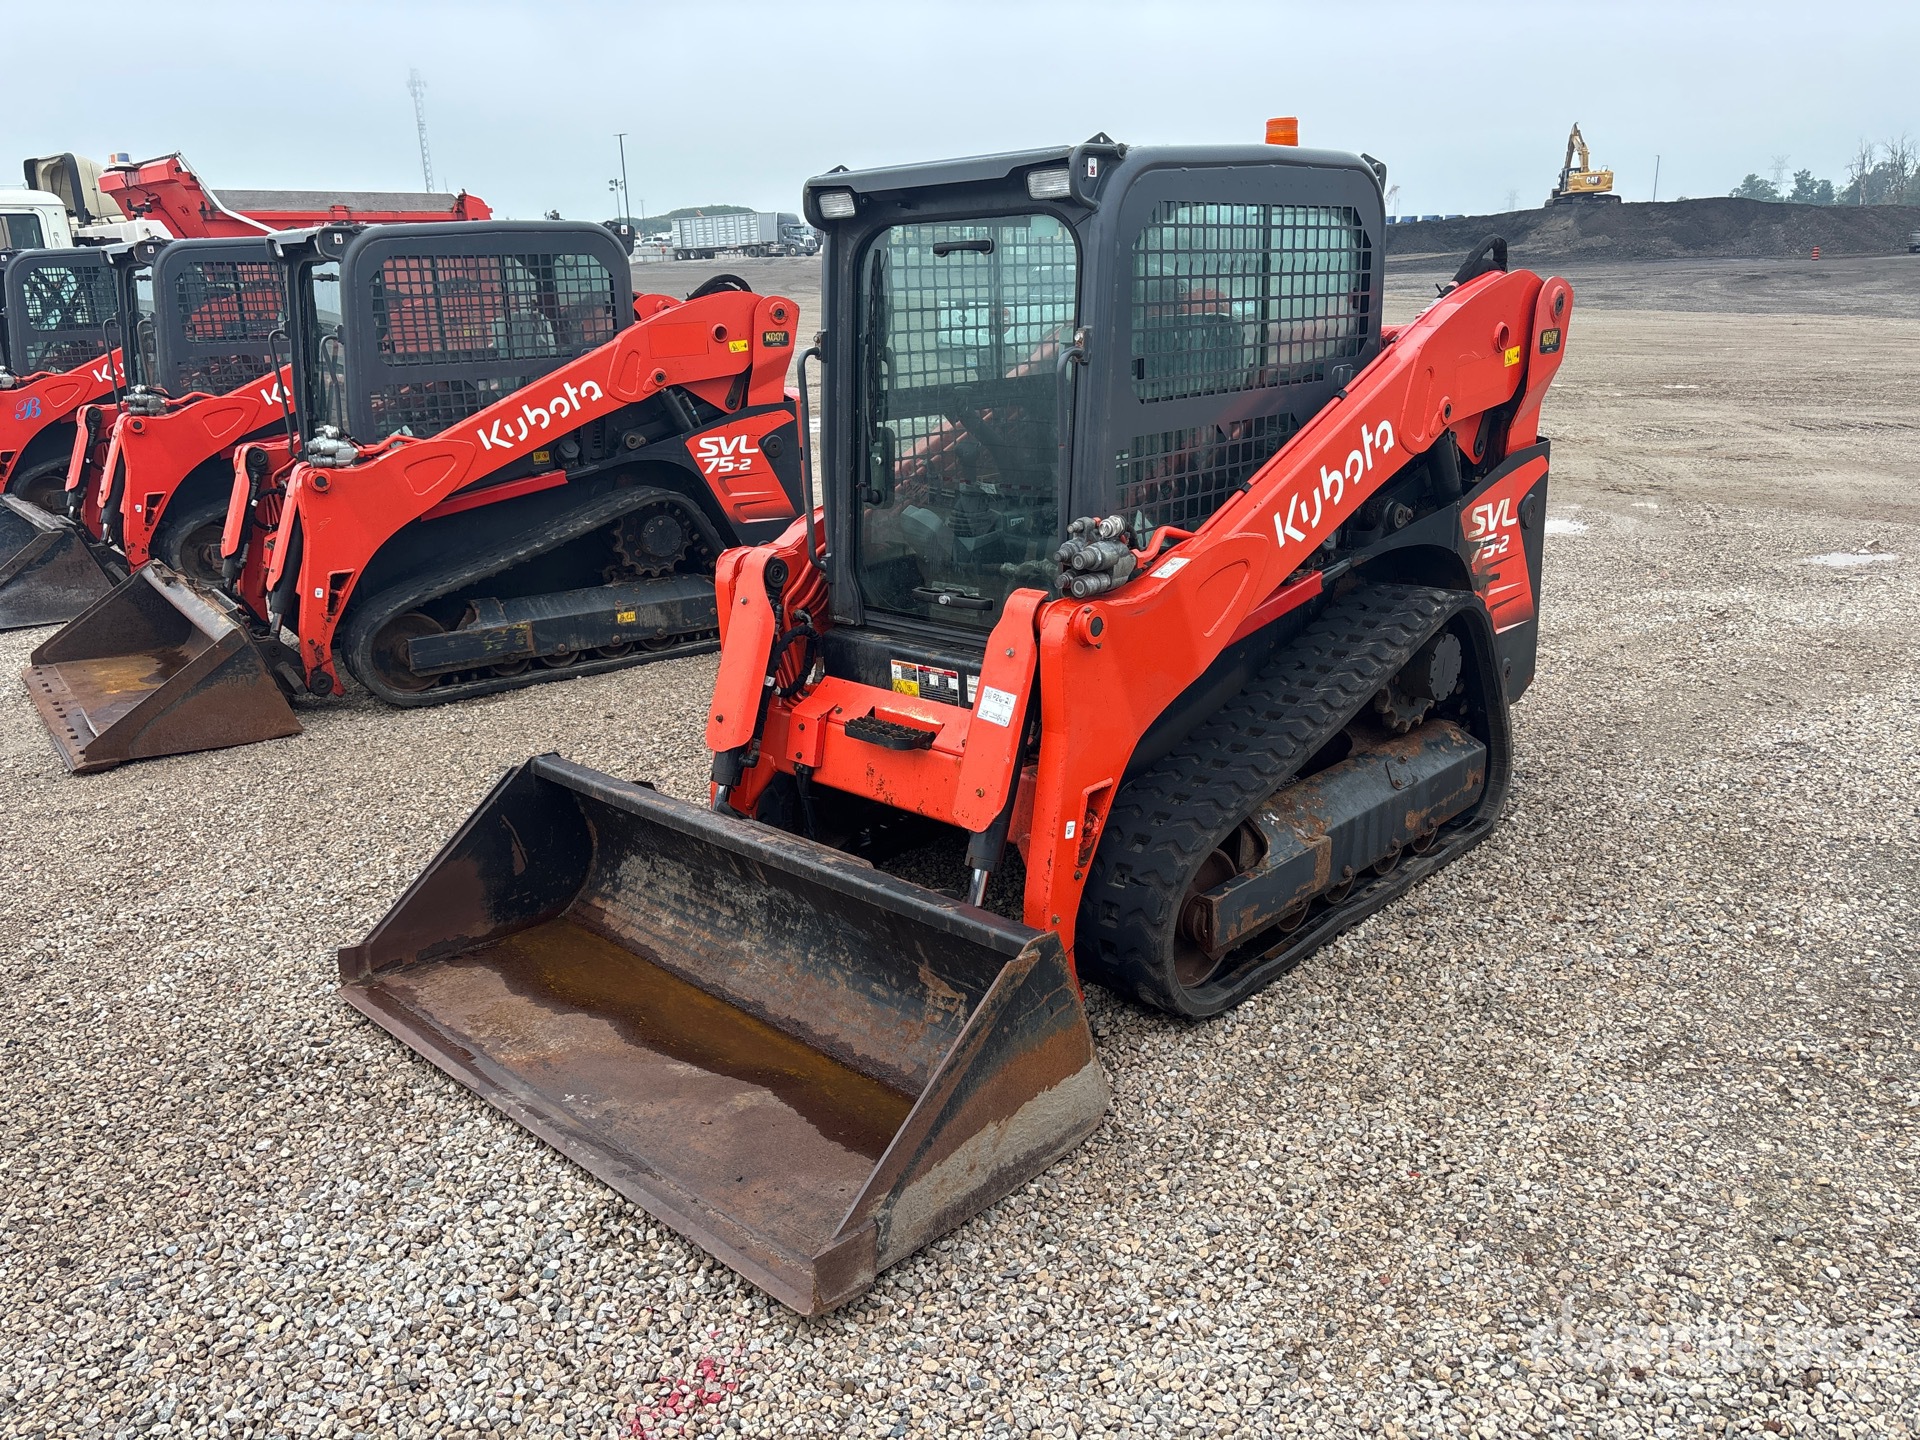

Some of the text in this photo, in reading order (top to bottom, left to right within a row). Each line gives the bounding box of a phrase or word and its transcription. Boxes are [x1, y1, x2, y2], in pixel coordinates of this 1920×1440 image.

[1586, 176, 1599, 184] CAT
[15, 396, 42, 420] B
[476, 380, 603, 450] Kubota
[697, 434, 759, 457] SVL
[703, 456, 752, 474] 75-2
[1273, 419, 1395, 548] Kubota
[1468, 498, 1517, 538] SVL
